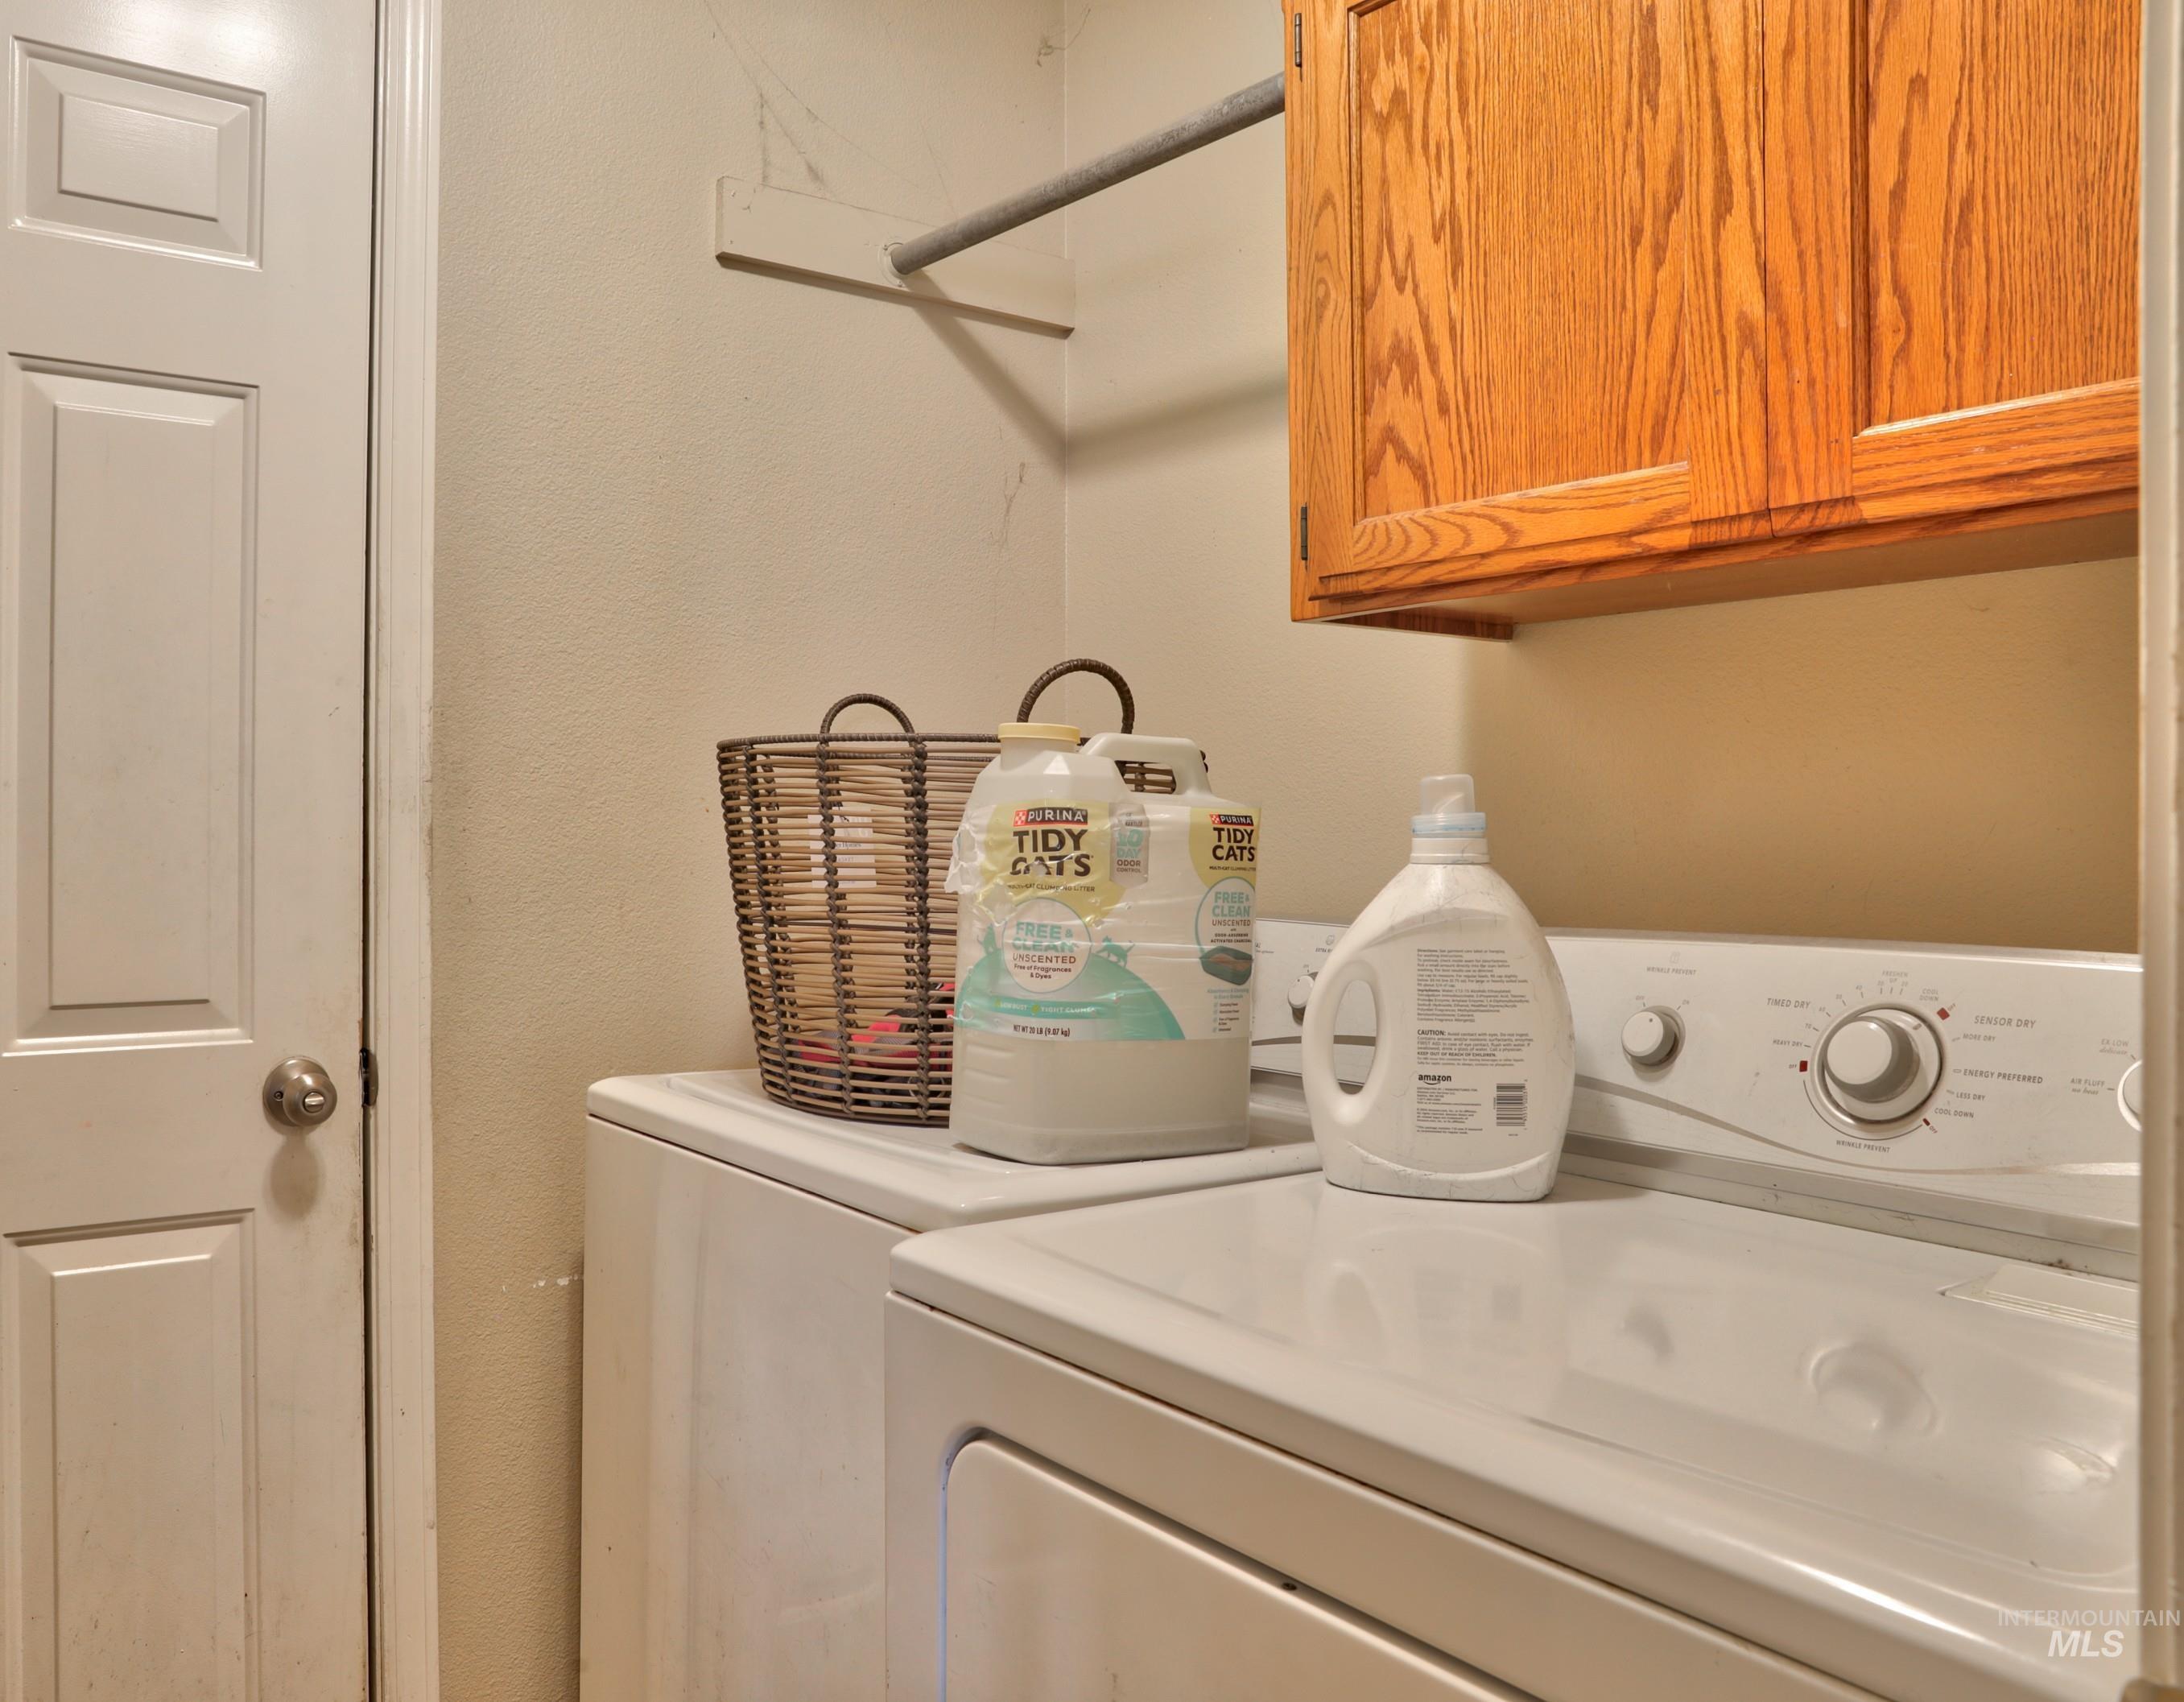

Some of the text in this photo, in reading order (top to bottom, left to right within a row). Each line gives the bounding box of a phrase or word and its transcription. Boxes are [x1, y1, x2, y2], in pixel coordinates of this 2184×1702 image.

[1027, 808, 1084, 822] PURINA
[1220, 816, 1253, 824] PURINA
[1013, 828, 1088, 853] TIDY
[1212, 827, 1254, 844] TIDY
[1117, 848, 1141, 858] DAY
[1212, 845, 1256, 861] CATS
[1009, 854, 1092, 877] CATS
[1117, 859, 1142, 867] ODOR
[1214, 891, 1244, 903] FREE
[1212, 905, 1250, 917] CLEAN
[1015, 921, 1073, 940] FREE &
[1011, 937, 1075, 953] CLEAN
[1012, 952, 1076, 964] UNSCENTED
[1033, 965, 1072, 973] Fragrances
[1671, 968, 1697, 976] PREVENT
[1766, 998, 1811, 1010] TIMED DRY
[1974, 1014, 2037, 1029] SENSOR DRY
[1013, 1024, 1021, 1032] NET
[1022, 1026, 1029, 1034] WT
[1030, 1027, 1035, 1035] 20
[1045, 1027, 1060, 1037] (9.07
[1060, 1027, 1071, 1038] kg)
[1963, 1033, 1996, 1043] MORE DRY
[2112, 1039, 2130, 1047] LOW
[1418, 1073, 1452, 1082] amazon
[1963, 1068, 2043, 1084] ENERGY PREFERRED
[2083, 1078, 2106, 1088] FLUFF
[1955, 1092, 1986, 1102] LESS DRY
[1934, 1107, 1975, 1118] COOL DOWN
[1835, 1139, 1891, 1155] WRINKLE PREVENT
